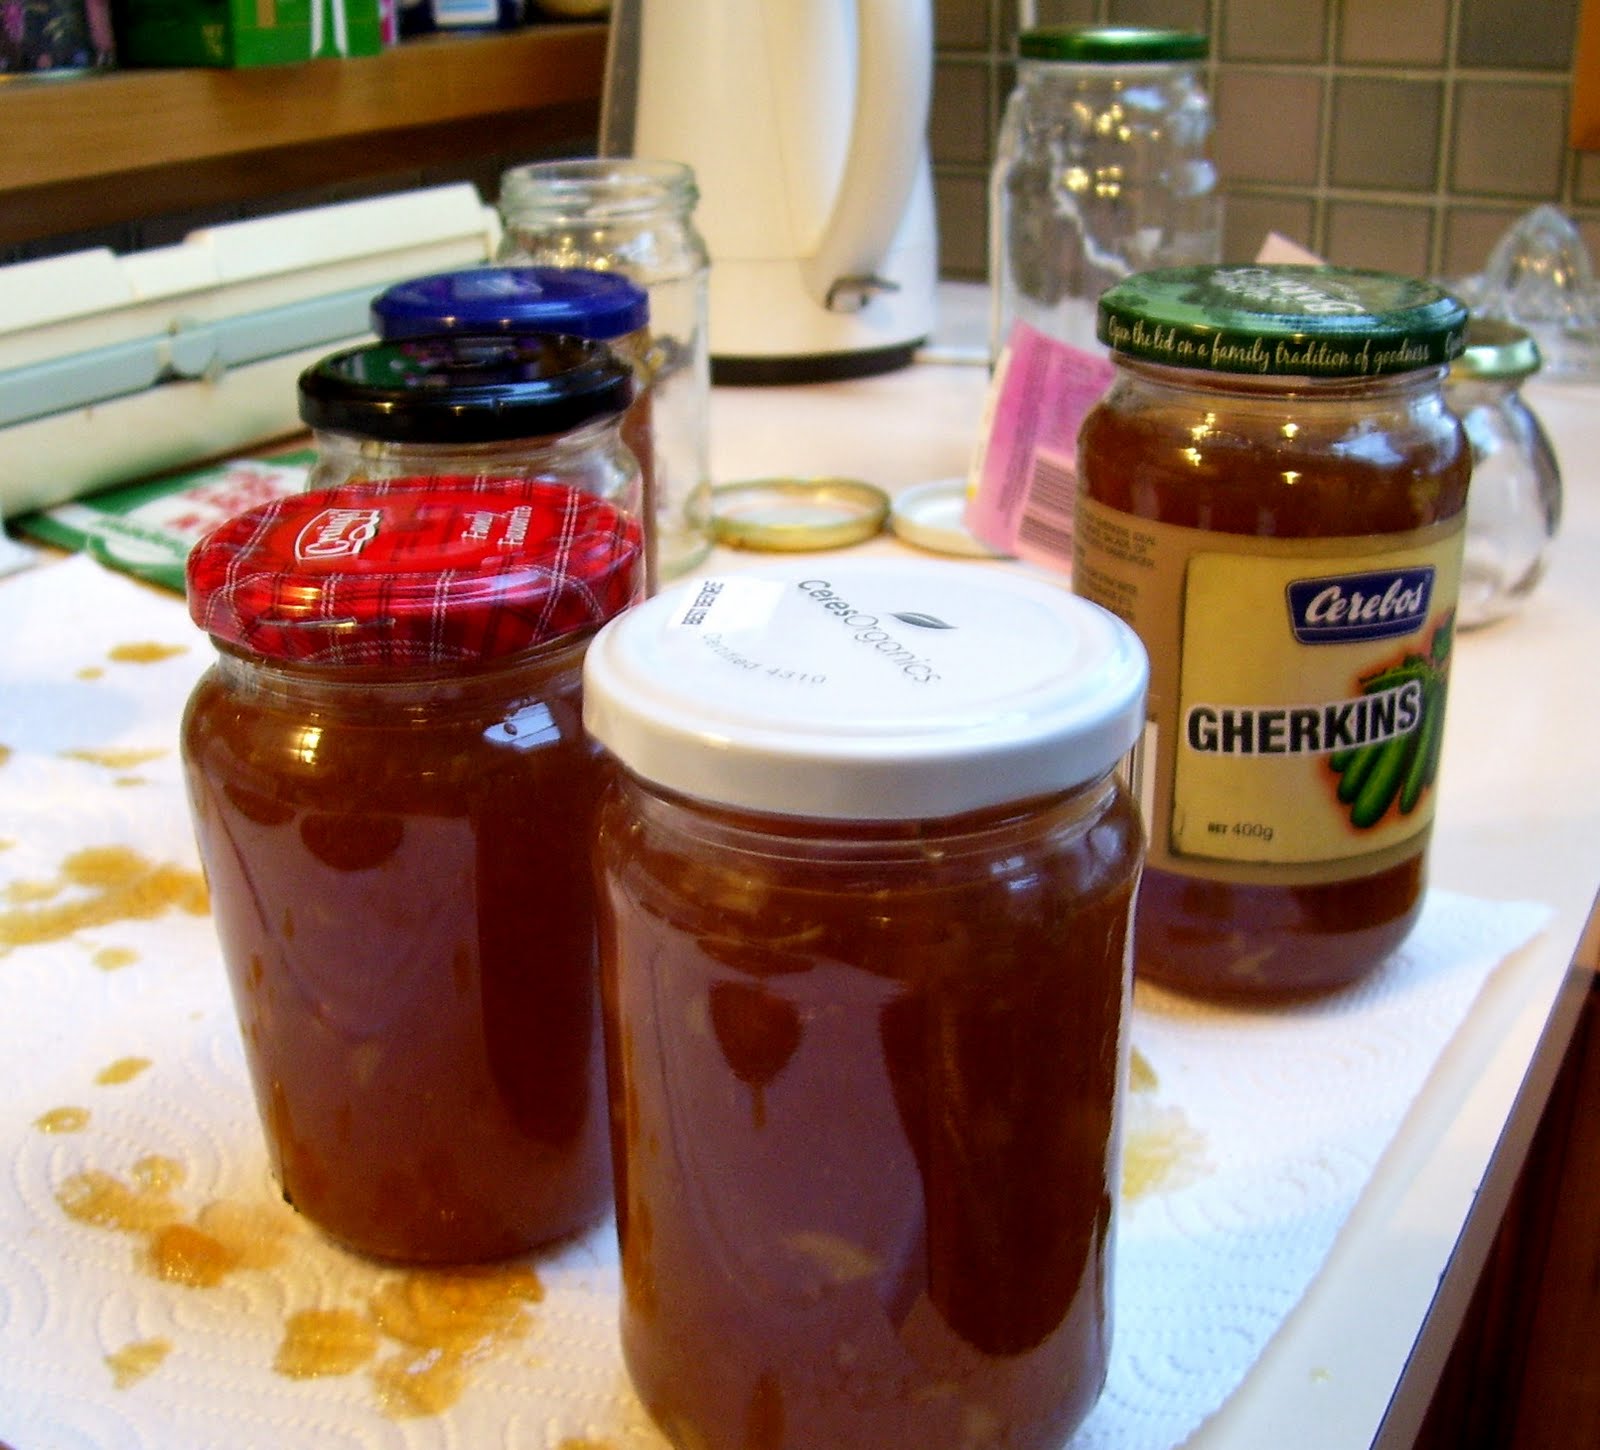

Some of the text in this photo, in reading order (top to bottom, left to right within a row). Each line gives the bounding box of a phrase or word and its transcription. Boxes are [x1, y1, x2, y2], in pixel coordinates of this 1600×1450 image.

[1132, 319, 1151, 347] the
[1153, 324, 1176, 351] lid
[1178, 340, 1194, 355] on
[1197, 343, 1209, 357] a
[1211, 332, 1269, 372] family
[1275, 340, 1350, 369] tradition
[1354, 338, 1371, 374] of
[1373, 337, 1430, 374] goodness
[1304, 578, 1424, 625] Cerebos
[1186, 682, 1420, 756] GHERKINS
[1231, 822, 1274, 841] 400g
